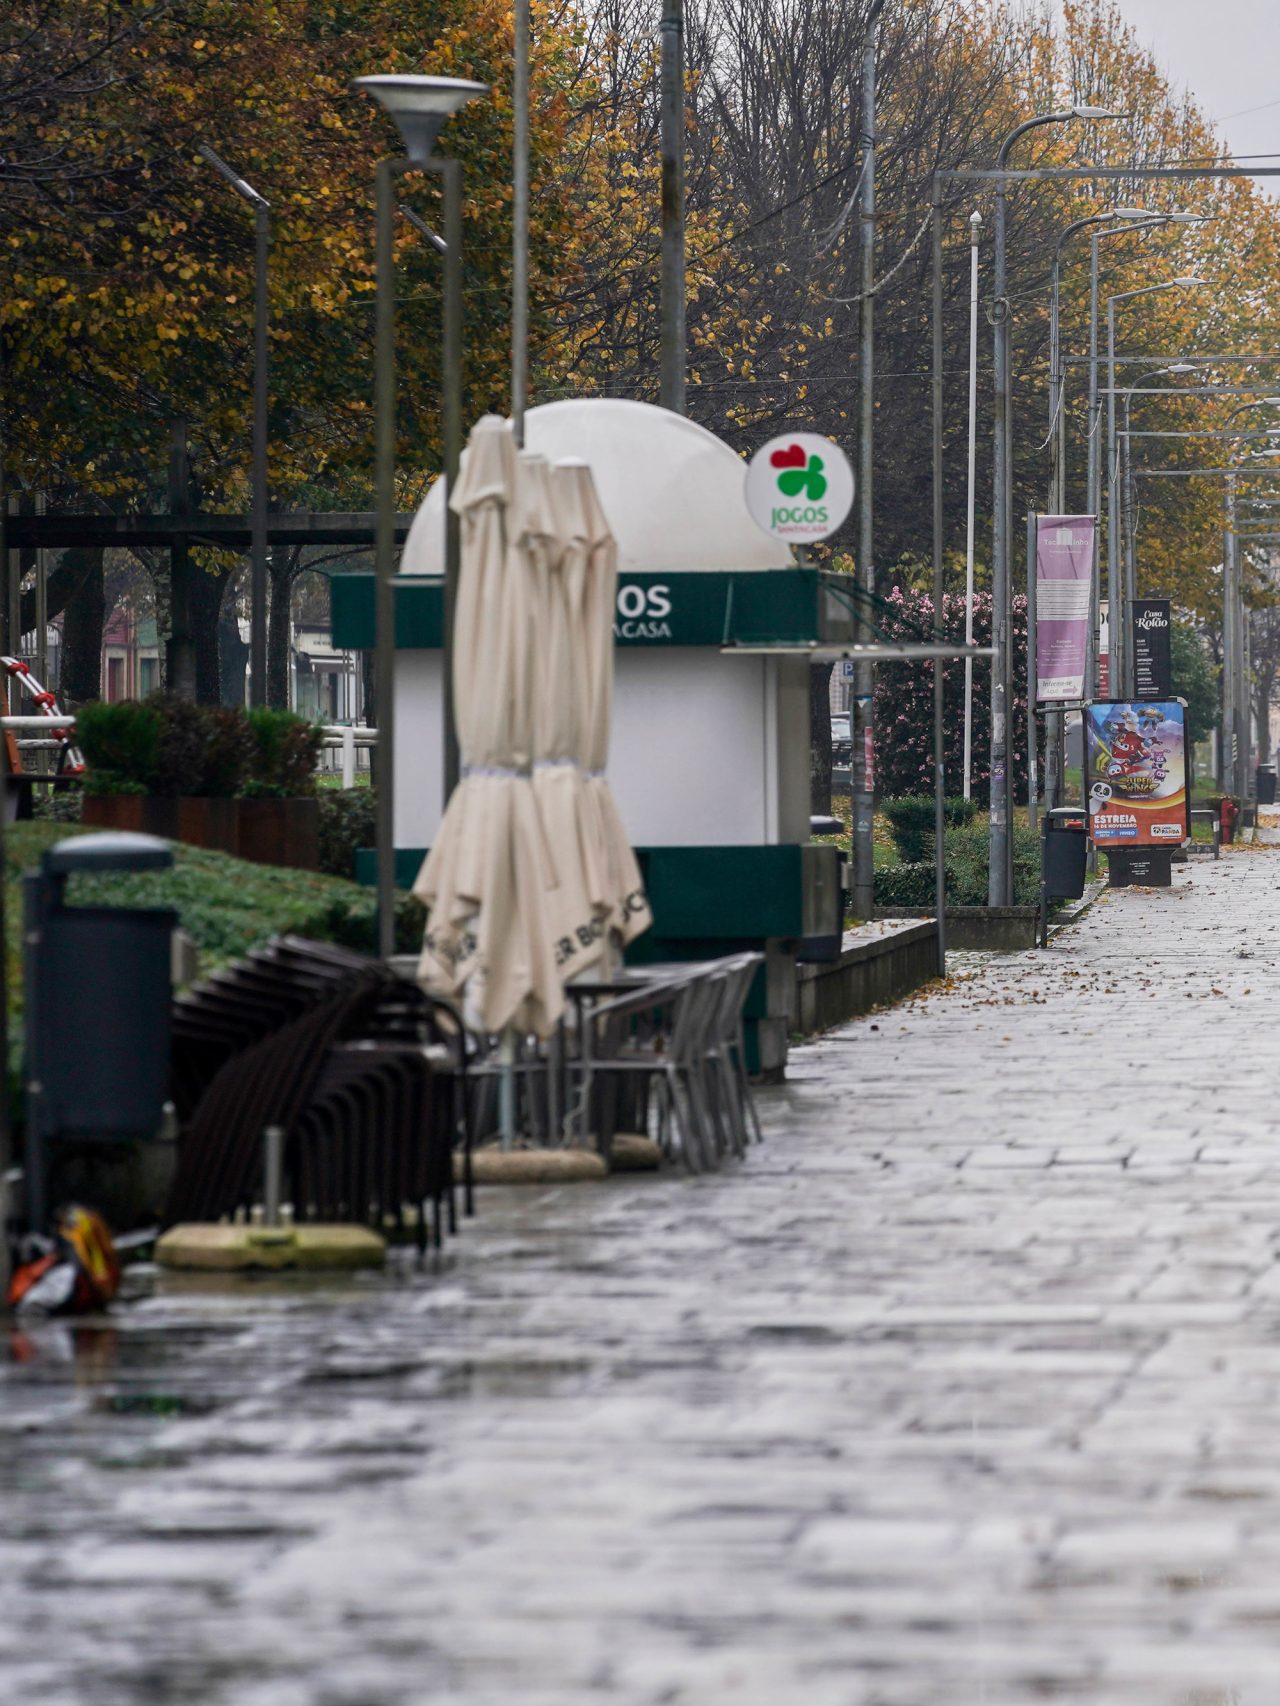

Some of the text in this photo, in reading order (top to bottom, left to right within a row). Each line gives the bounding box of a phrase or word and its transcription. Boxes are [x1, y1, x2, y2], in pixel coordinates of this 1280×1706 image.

[771, 506, 829, 530] JOGOS
[1144, 610, 1163, 620] Casa
[844, 663, 853, 675] P
[1094, 814, 1137, 824] ESTREIA
